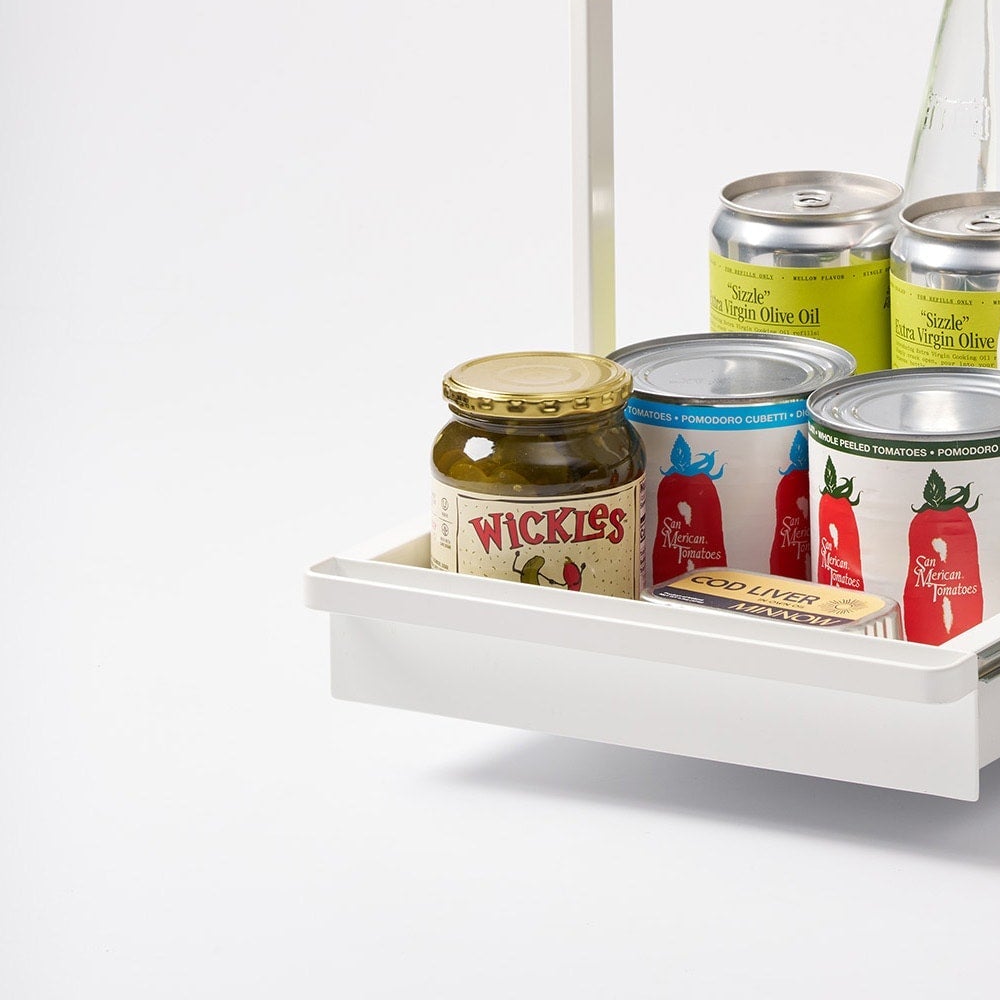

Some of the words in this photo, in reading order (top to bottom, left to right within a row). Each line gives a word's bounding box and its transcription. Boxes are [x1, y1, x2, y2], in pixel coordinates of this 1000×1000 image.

[724, 299, 756, 322] Virgin
[760, 306, 794, 324] Olive
[798, 308, 820, 324] Oil
[895, 318, 915, 340] Extra
[917, 327, 954, 350] Virgin
[958, 333, 994, 349] Olive
[627, 405, 672, 422] TOMATOES
[681, 414, 743, 425] POMODORO
[745, 412, 787, 424] CUBETTI
[818, 430, 838, 446] WHOLE
[839, 439, 870, 453] PEELED
[872, 445, 927, 457] TOMATOES
[937, 444, 999, 457] POMODORO
[661, 517, 682, 536] San
[672, 544, 721, 564] Tomatoes
[914, 555, 936, 575] San
[690, 575, 747, 592] COD
[747, 585, 820, 605] LIVER
[928, 582, 978, 603] Tomatoes
[728, 602, 841, 626] MINNOW
